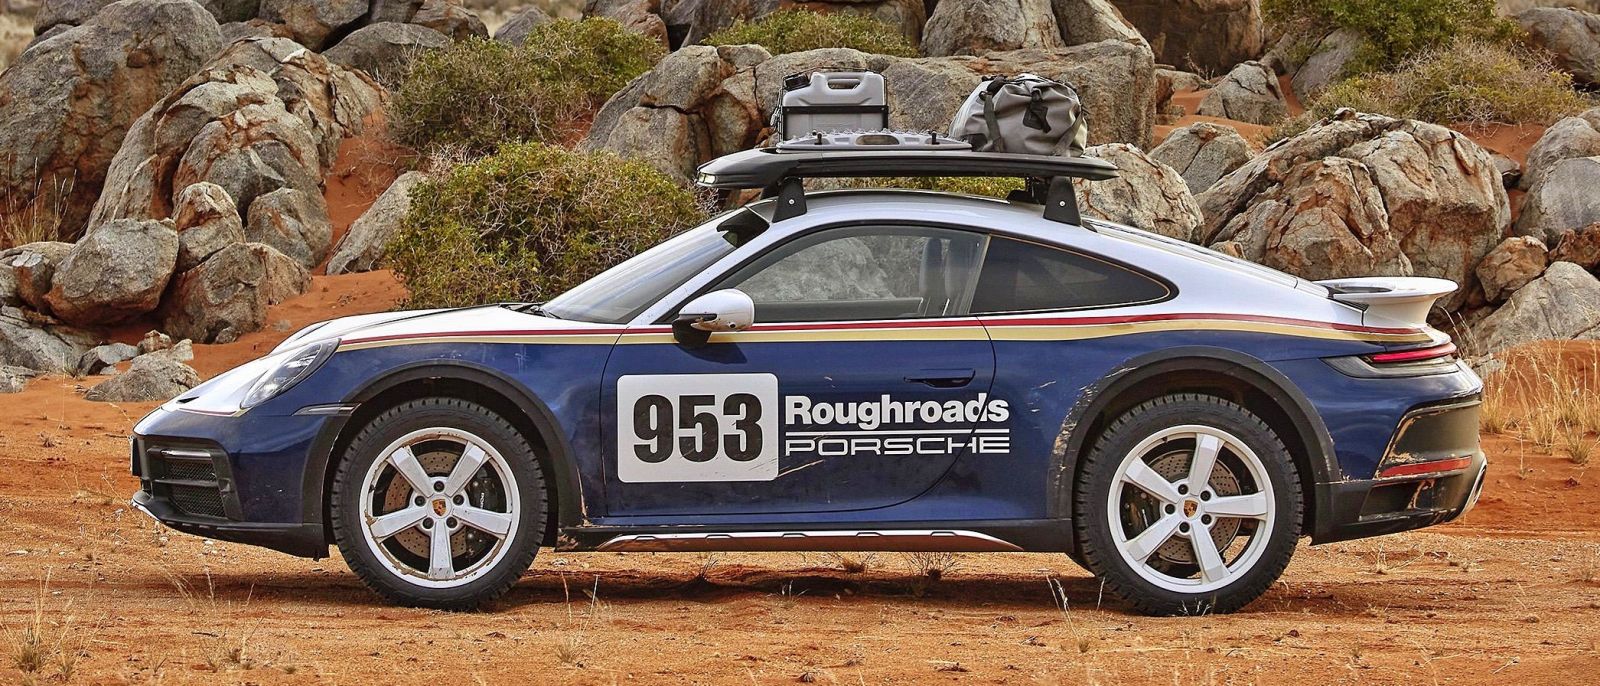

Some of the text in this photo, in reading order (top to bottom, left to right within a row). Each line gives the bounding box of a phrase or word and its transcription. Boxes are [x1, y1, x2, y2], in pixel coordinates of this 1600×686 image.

[633, 393, 763, 464] 953
[785, 393, 1010, 431] Roughroads
[785, 437, 1010, 457] PORSCHE
